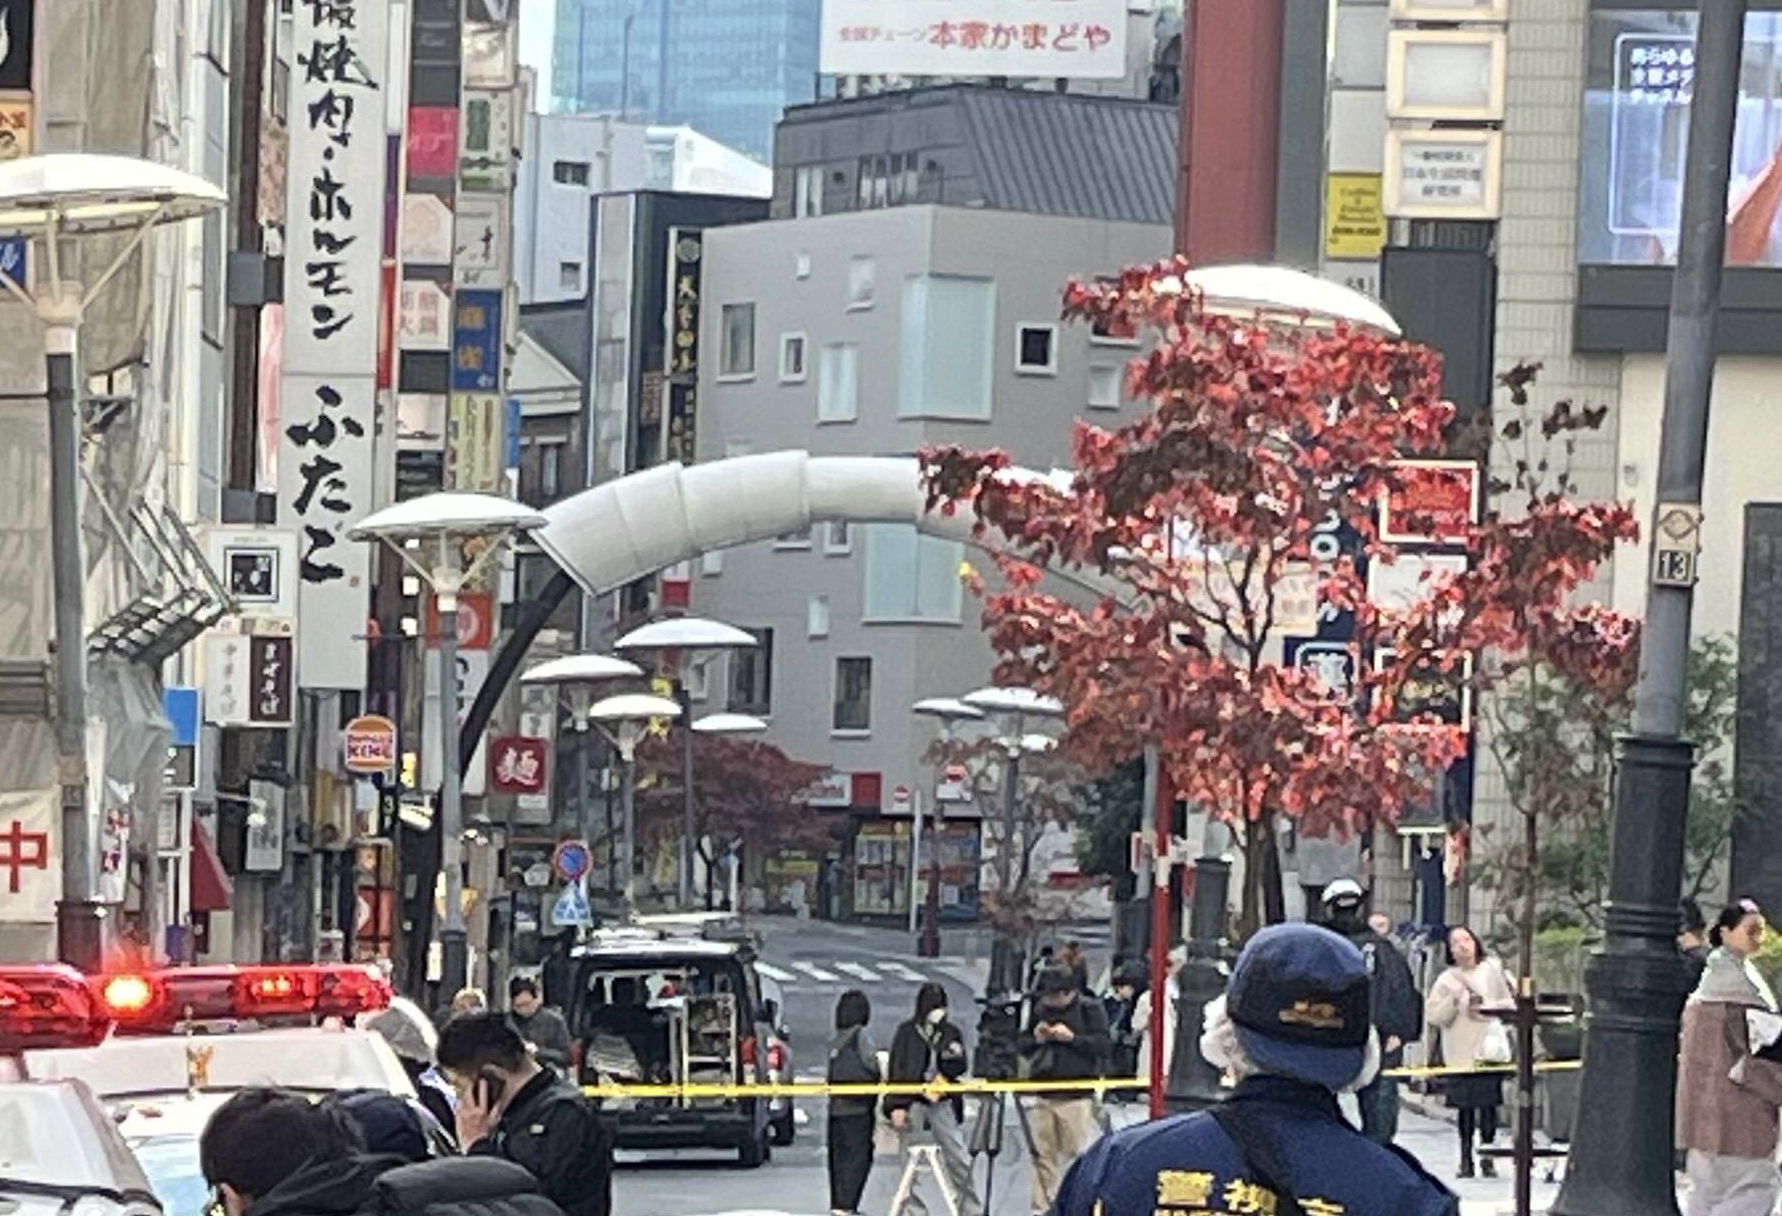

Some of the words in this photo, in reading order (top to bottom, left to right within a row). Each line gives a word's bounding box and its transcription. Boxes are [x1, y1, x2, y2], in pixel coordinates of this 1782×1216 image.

[927, 20, 1112, 51] 本家かまどや
[285, 385, 365, 584] ふたご
[1660, 551, 1687, 580] 13
